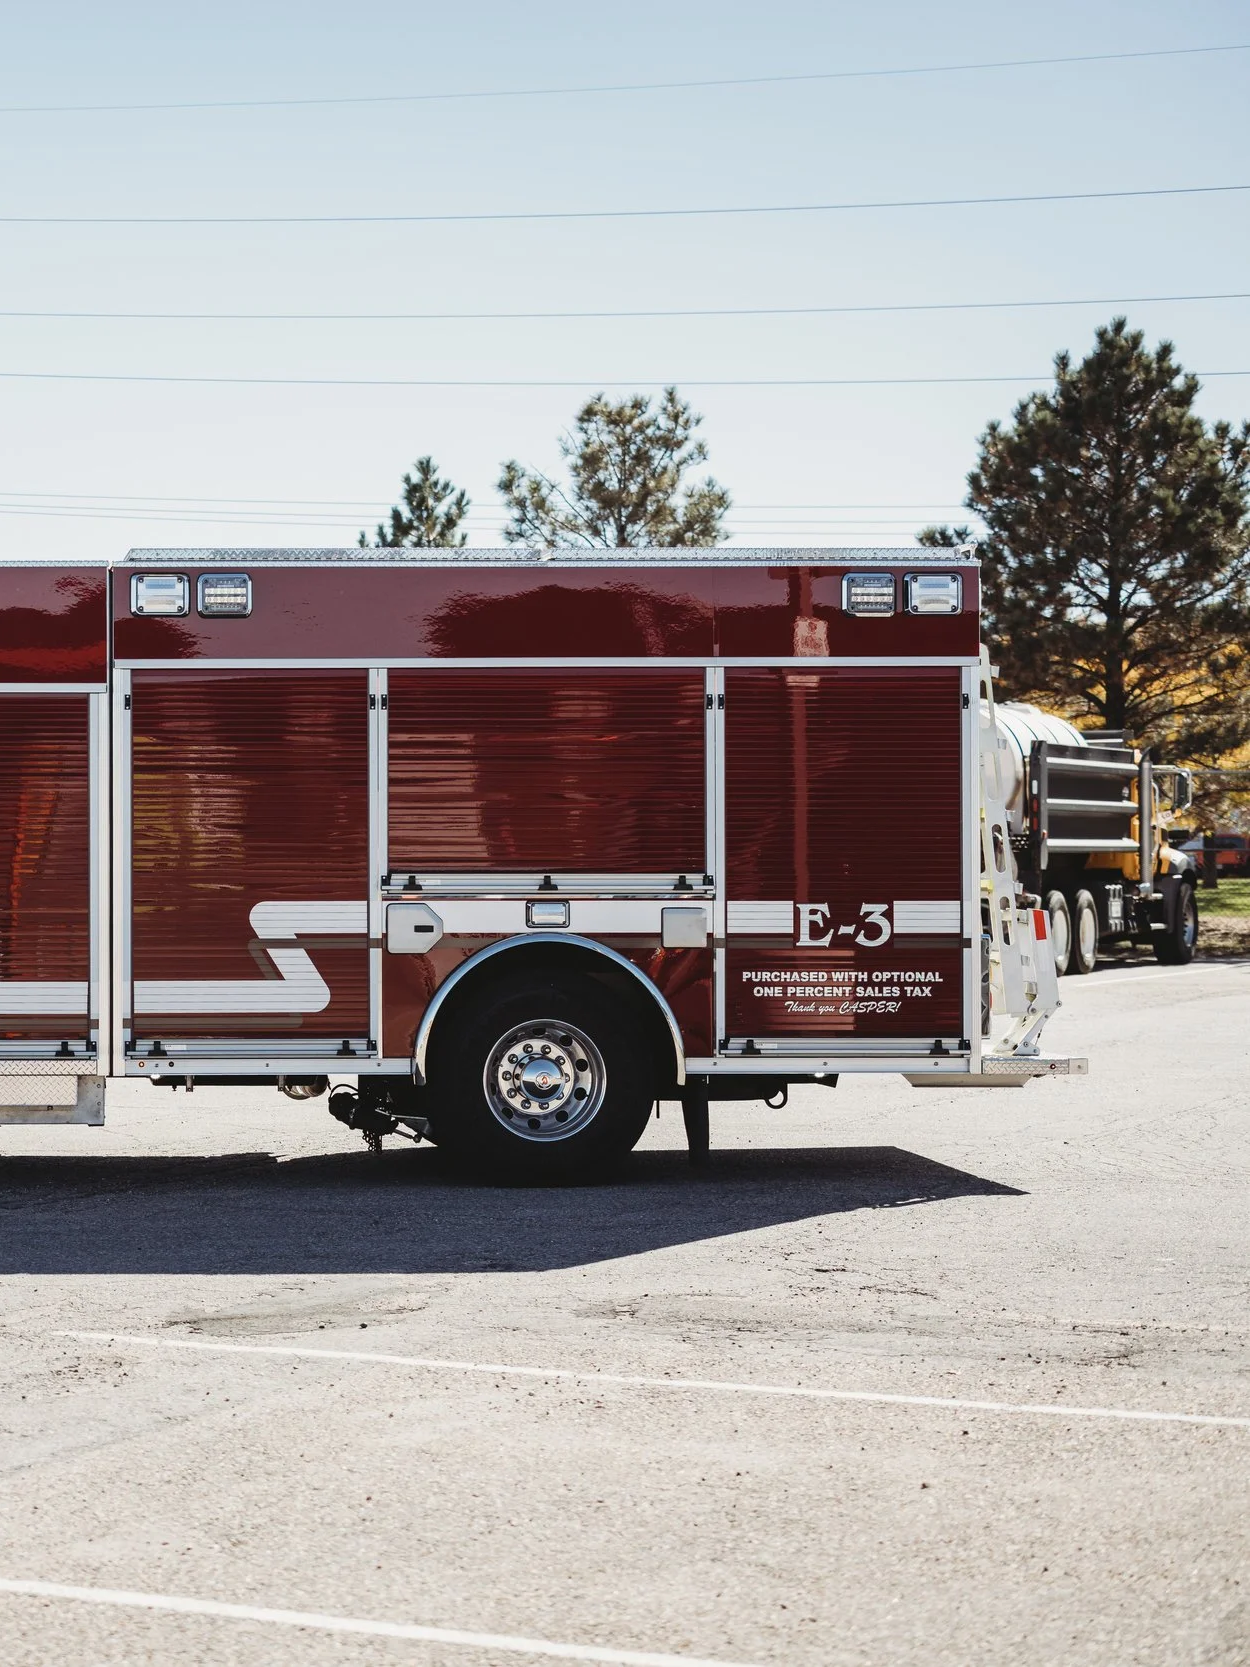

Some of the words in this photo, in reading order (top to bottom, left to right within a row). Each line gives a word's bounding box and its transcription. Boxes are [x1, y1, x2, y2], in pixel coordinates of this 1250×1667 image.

[796, 902, 892, 948] E-3
[742, 971, 828, 982] PURCHASED
[831, 971, 868, 982] WITH
[872, 971, 944, 982] OPTIONAL
[753, 986, 783, 997] ONE
[787, 986, 852, 997] PERCENT
[856, 986, 901, 997] SALES
[904, 986, 932, 997] TAX
[784, 1001, 816, 1013] Thank
[818, 1004, 835, 1014] you
[839, 1001, 902, 1014] CASPER!
